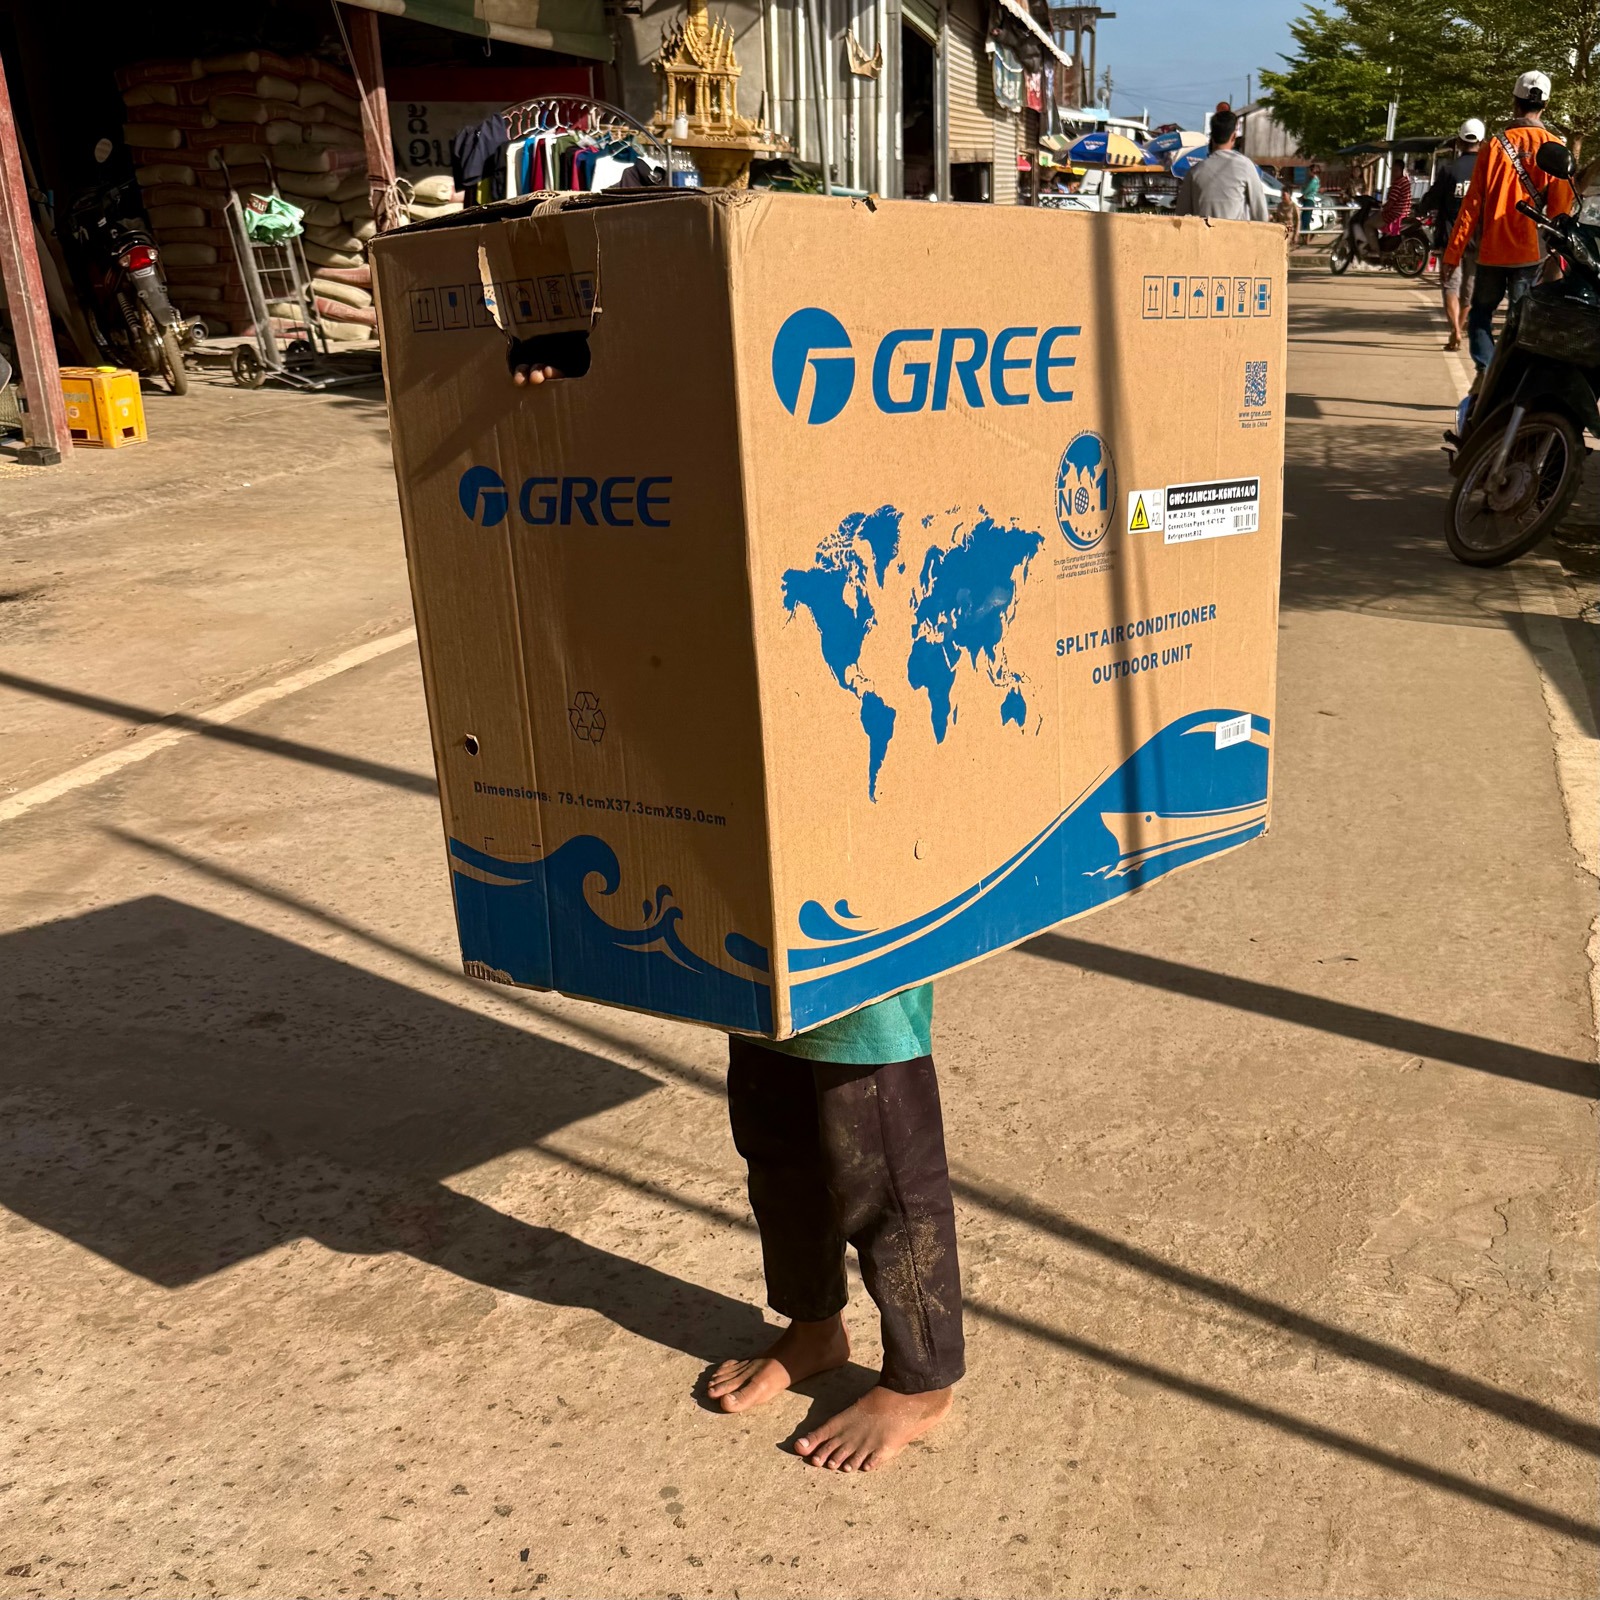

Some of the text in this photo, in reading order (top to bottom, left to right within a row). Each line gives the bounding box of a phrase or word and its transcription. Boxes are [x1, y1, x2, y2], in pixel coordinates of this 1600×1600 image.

[871, 325, 1082, 414] GREE
[519, 476, 673, 528] GREE
[1056, 603, 1217, 657] SPLIT AIR CONDITIONER
[1092, 643, 1193, 685] OUTDOOR UNIT
[474, 781, 727, 826] Dimensions: 79.1cmX37.3cmX59.0cm
